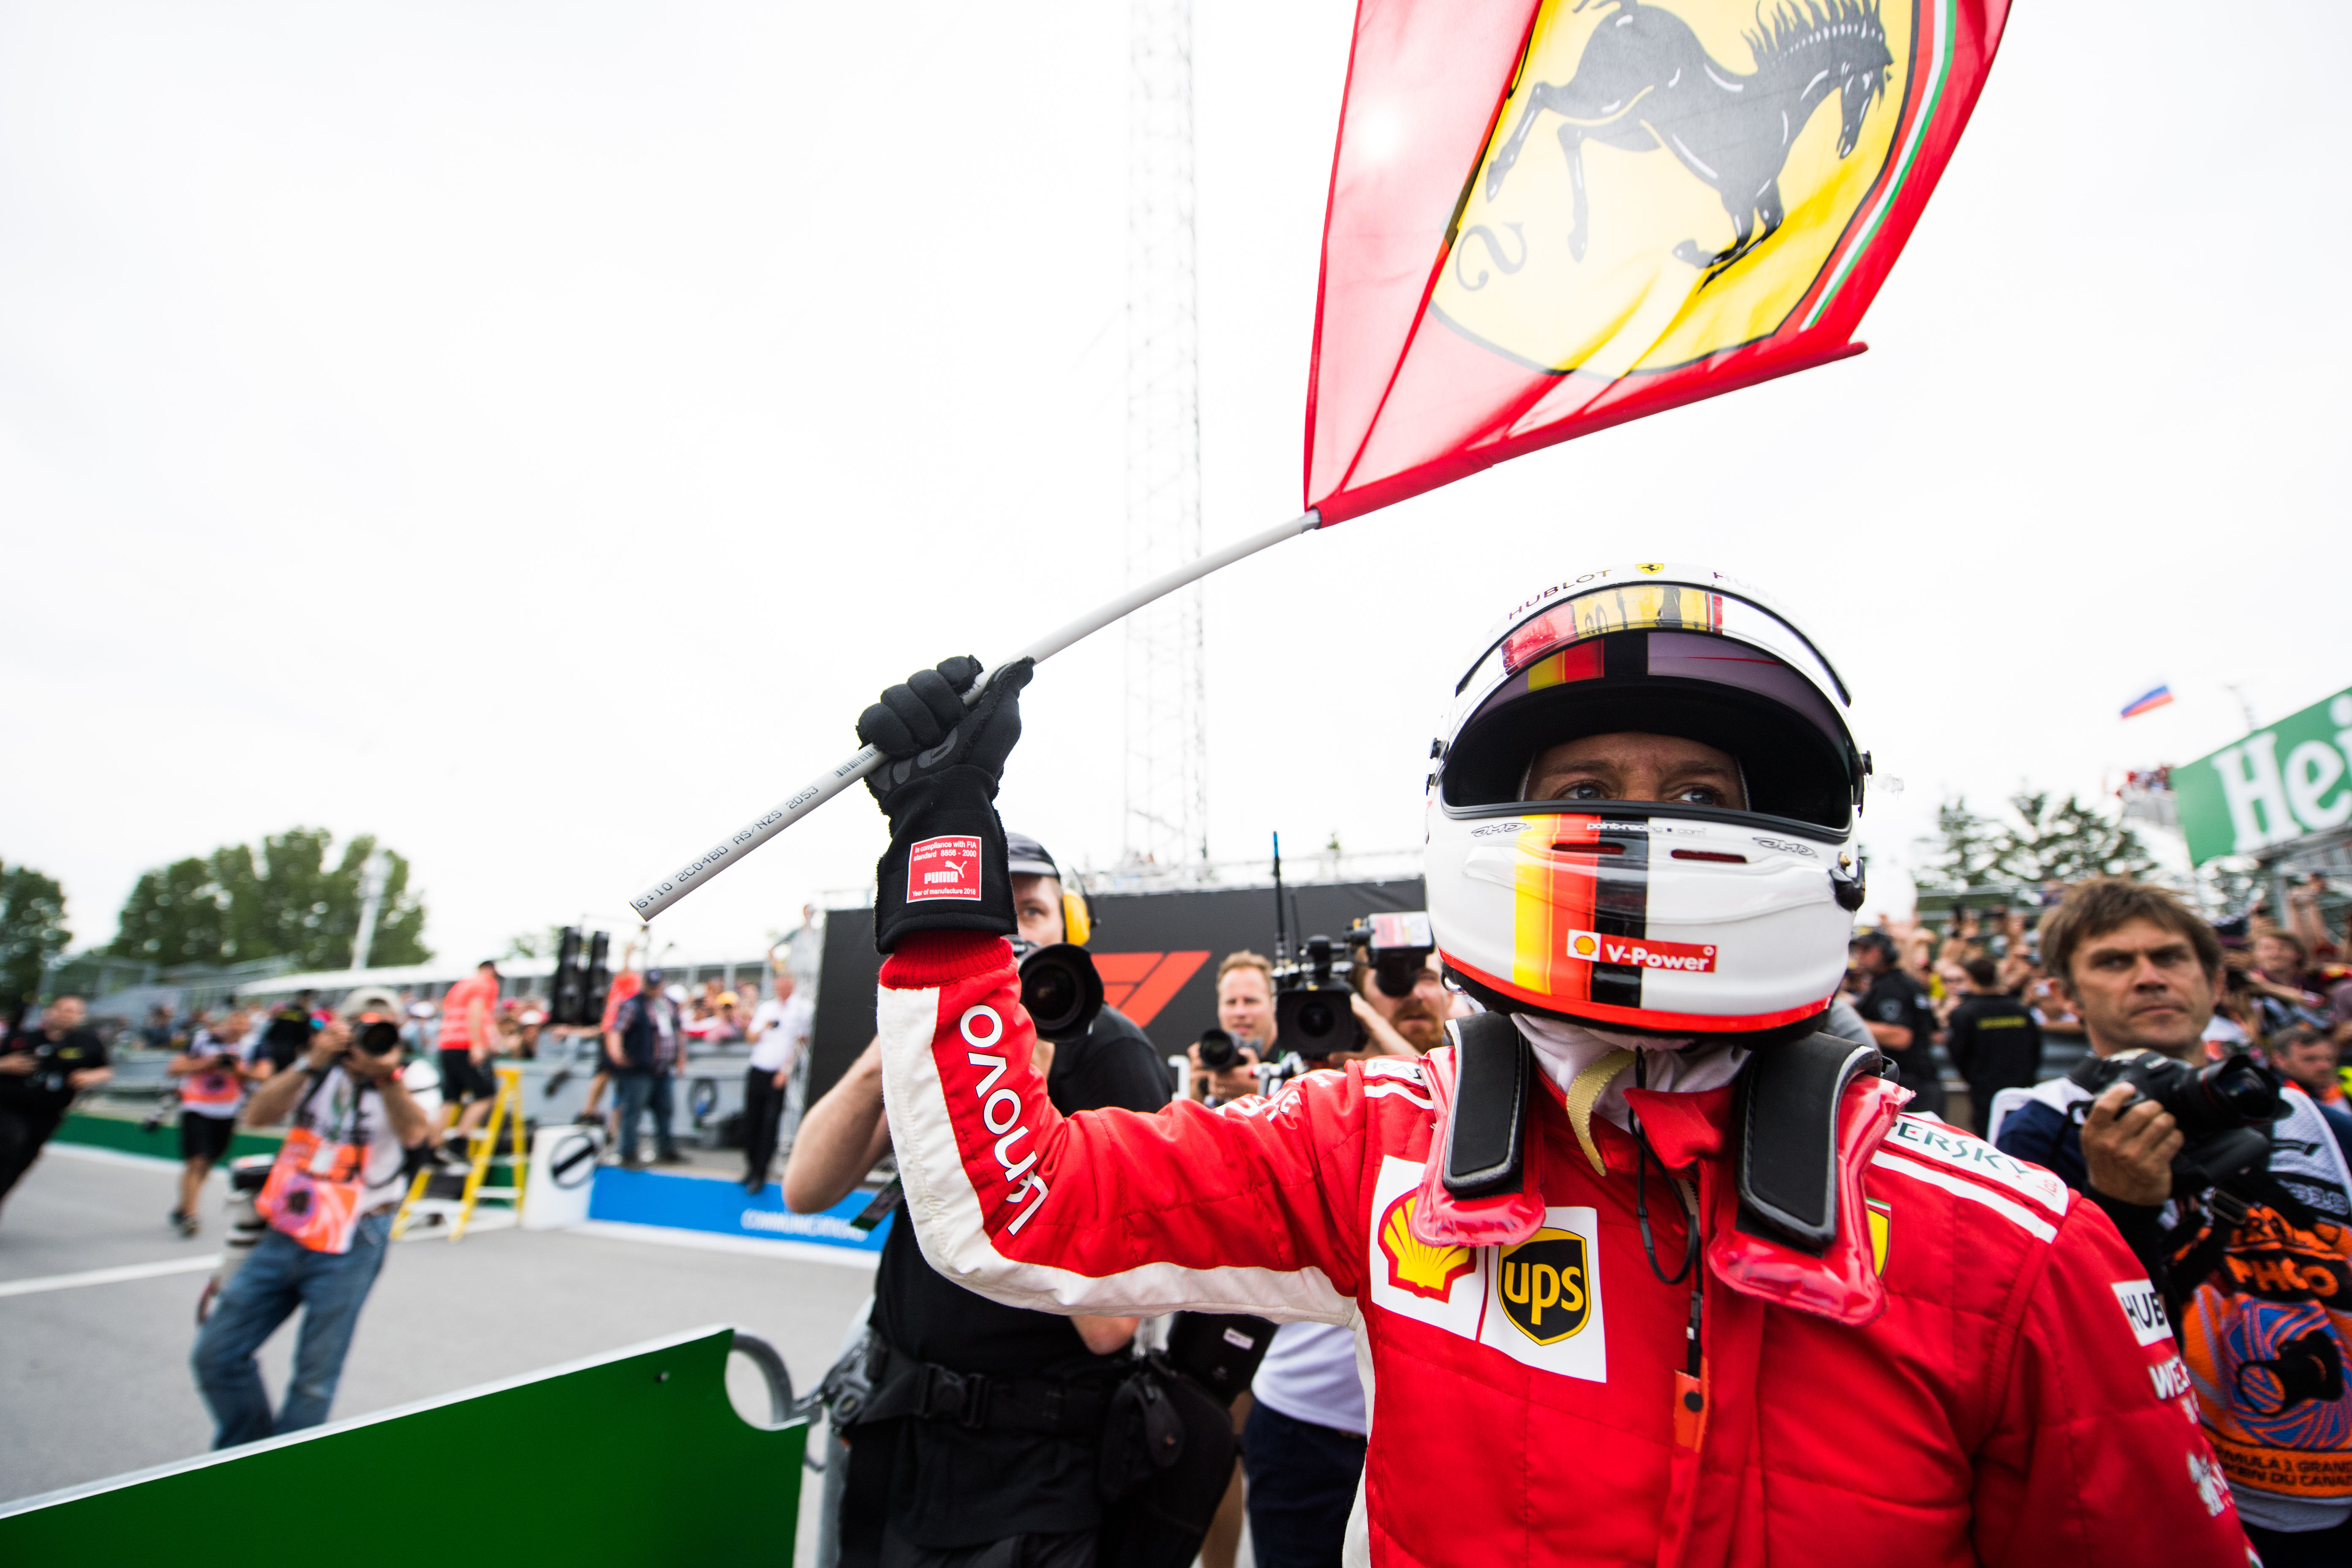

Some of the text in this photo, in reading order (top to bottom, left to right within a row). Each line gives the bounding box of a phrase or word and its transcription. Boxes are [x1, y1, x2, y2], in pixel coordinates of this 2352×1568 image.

[1509, 569, 1612, 620] HUBLOT
[732, 810, 782, 844] AS/NZS
[786, 786, 818, 809] 2053
[913, 851, 936, 861] standard
[920, 842, 952, 851] compliance
[924, 871, 958, 884] PUMA
[1606, 943, 1710, 971] V-Power
[1373, 1062, 1422, 1080] KAS
[1892, 1122, 2033, 1175] ERSKY
[1504, 1261, 1584, 1326] ups
[2121, 1292, 2167, 1332] HUB
